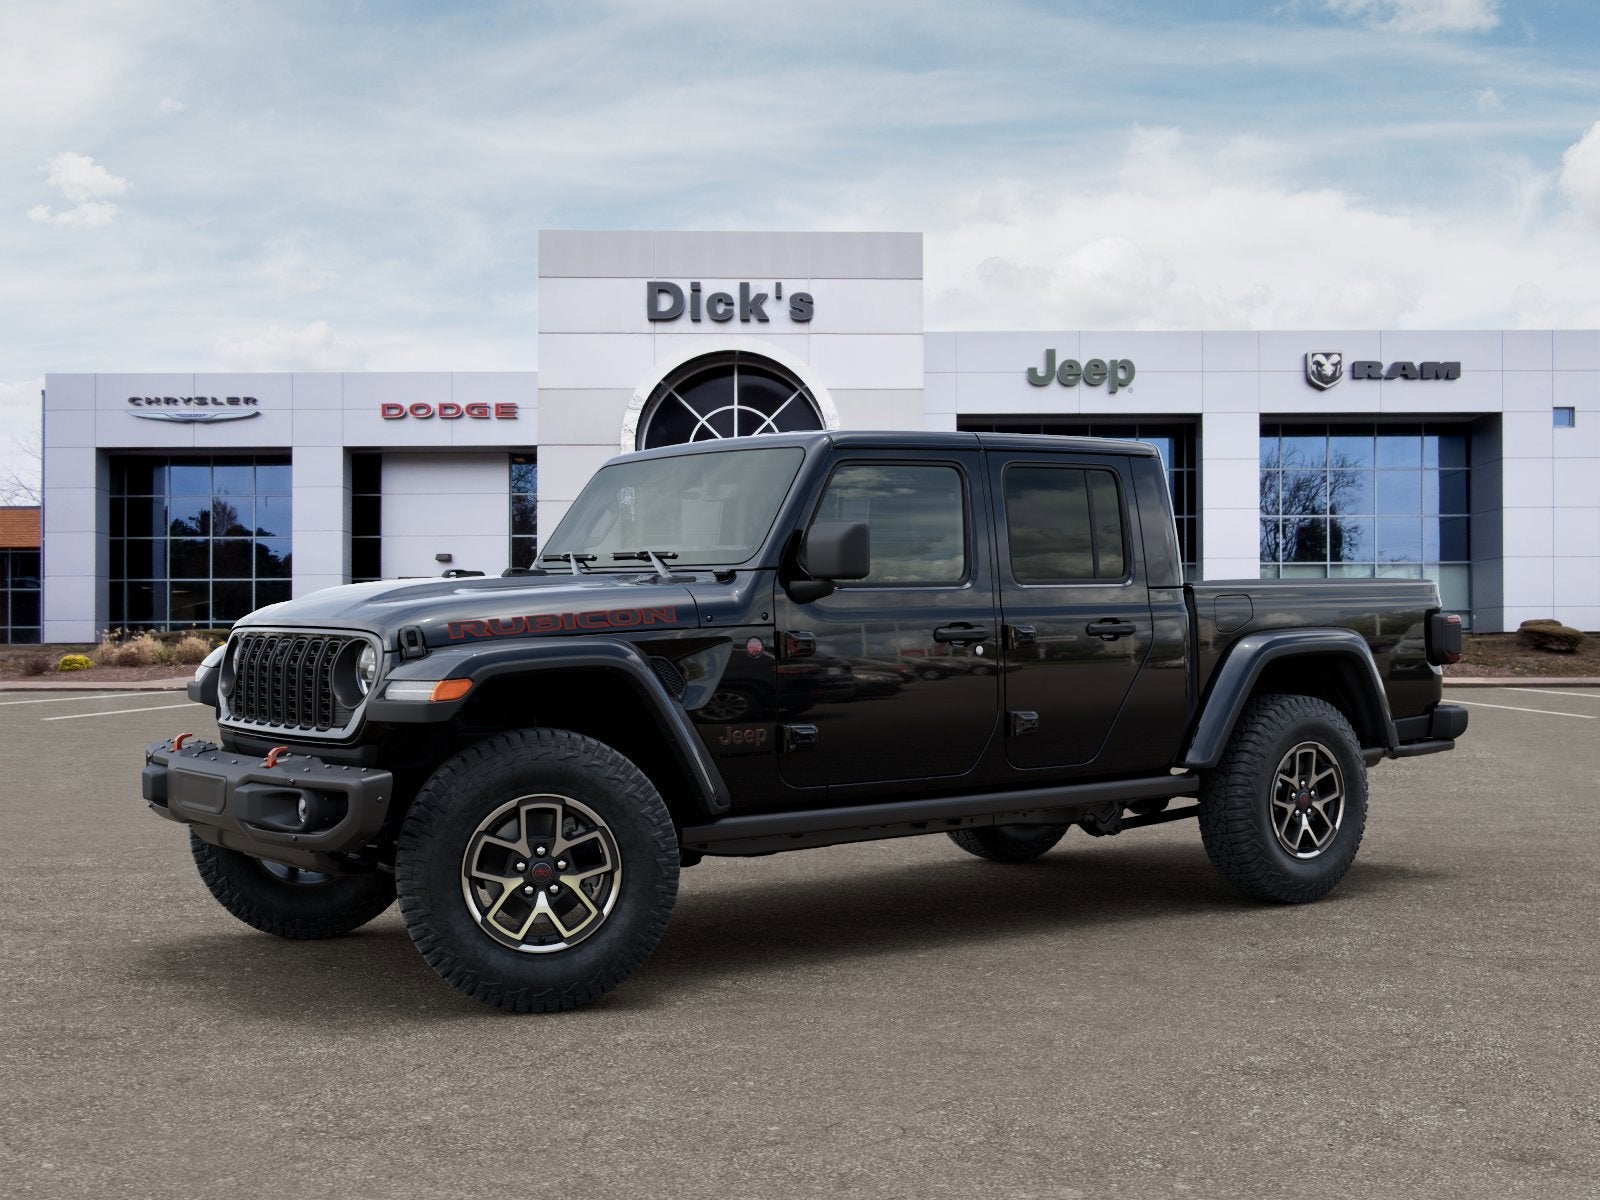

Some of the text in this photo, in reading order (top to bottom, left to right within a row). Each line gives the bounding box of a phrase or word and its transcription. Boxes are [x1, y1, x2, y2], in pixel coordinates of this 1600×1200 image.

[647, 281, 814, 322] Dick's
[1027, 348, 1136, 394] Jeep
[1351, 360, 1462, 380] RAM
[128, 396, 259, 406] CHRYSLER
[381, 402, 519, 420] DODGE
[447, 605, 678, 640] RUBICON
[719, 726, 768, 747] Jeep
